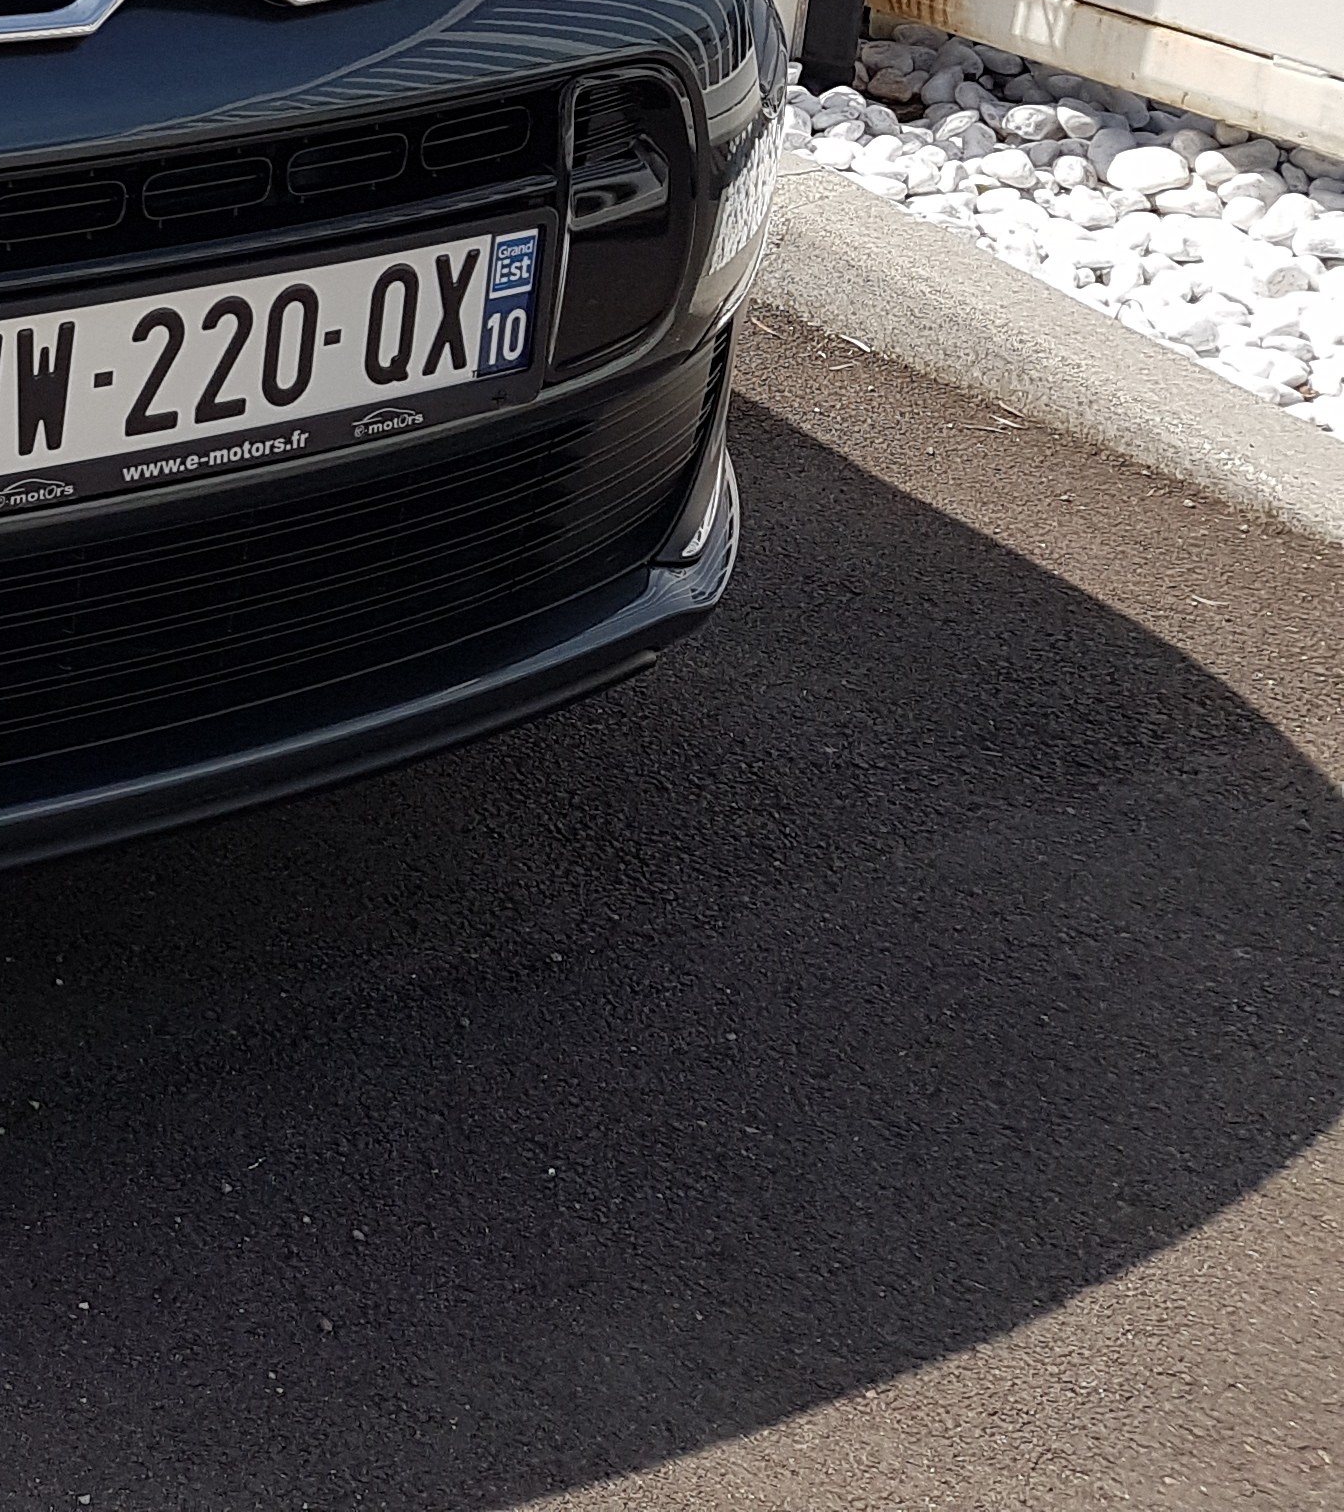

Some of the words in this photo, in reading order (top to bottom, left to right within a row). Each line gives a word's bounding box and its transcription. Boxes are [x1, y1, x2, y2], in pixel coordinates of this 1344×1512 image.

[495, 255, 531, 284] Est
[498, 239, 534, 259] Grand
[487, 308, 527, 365] 10
[122, 429, 310, 482] www.e-motors.fr
